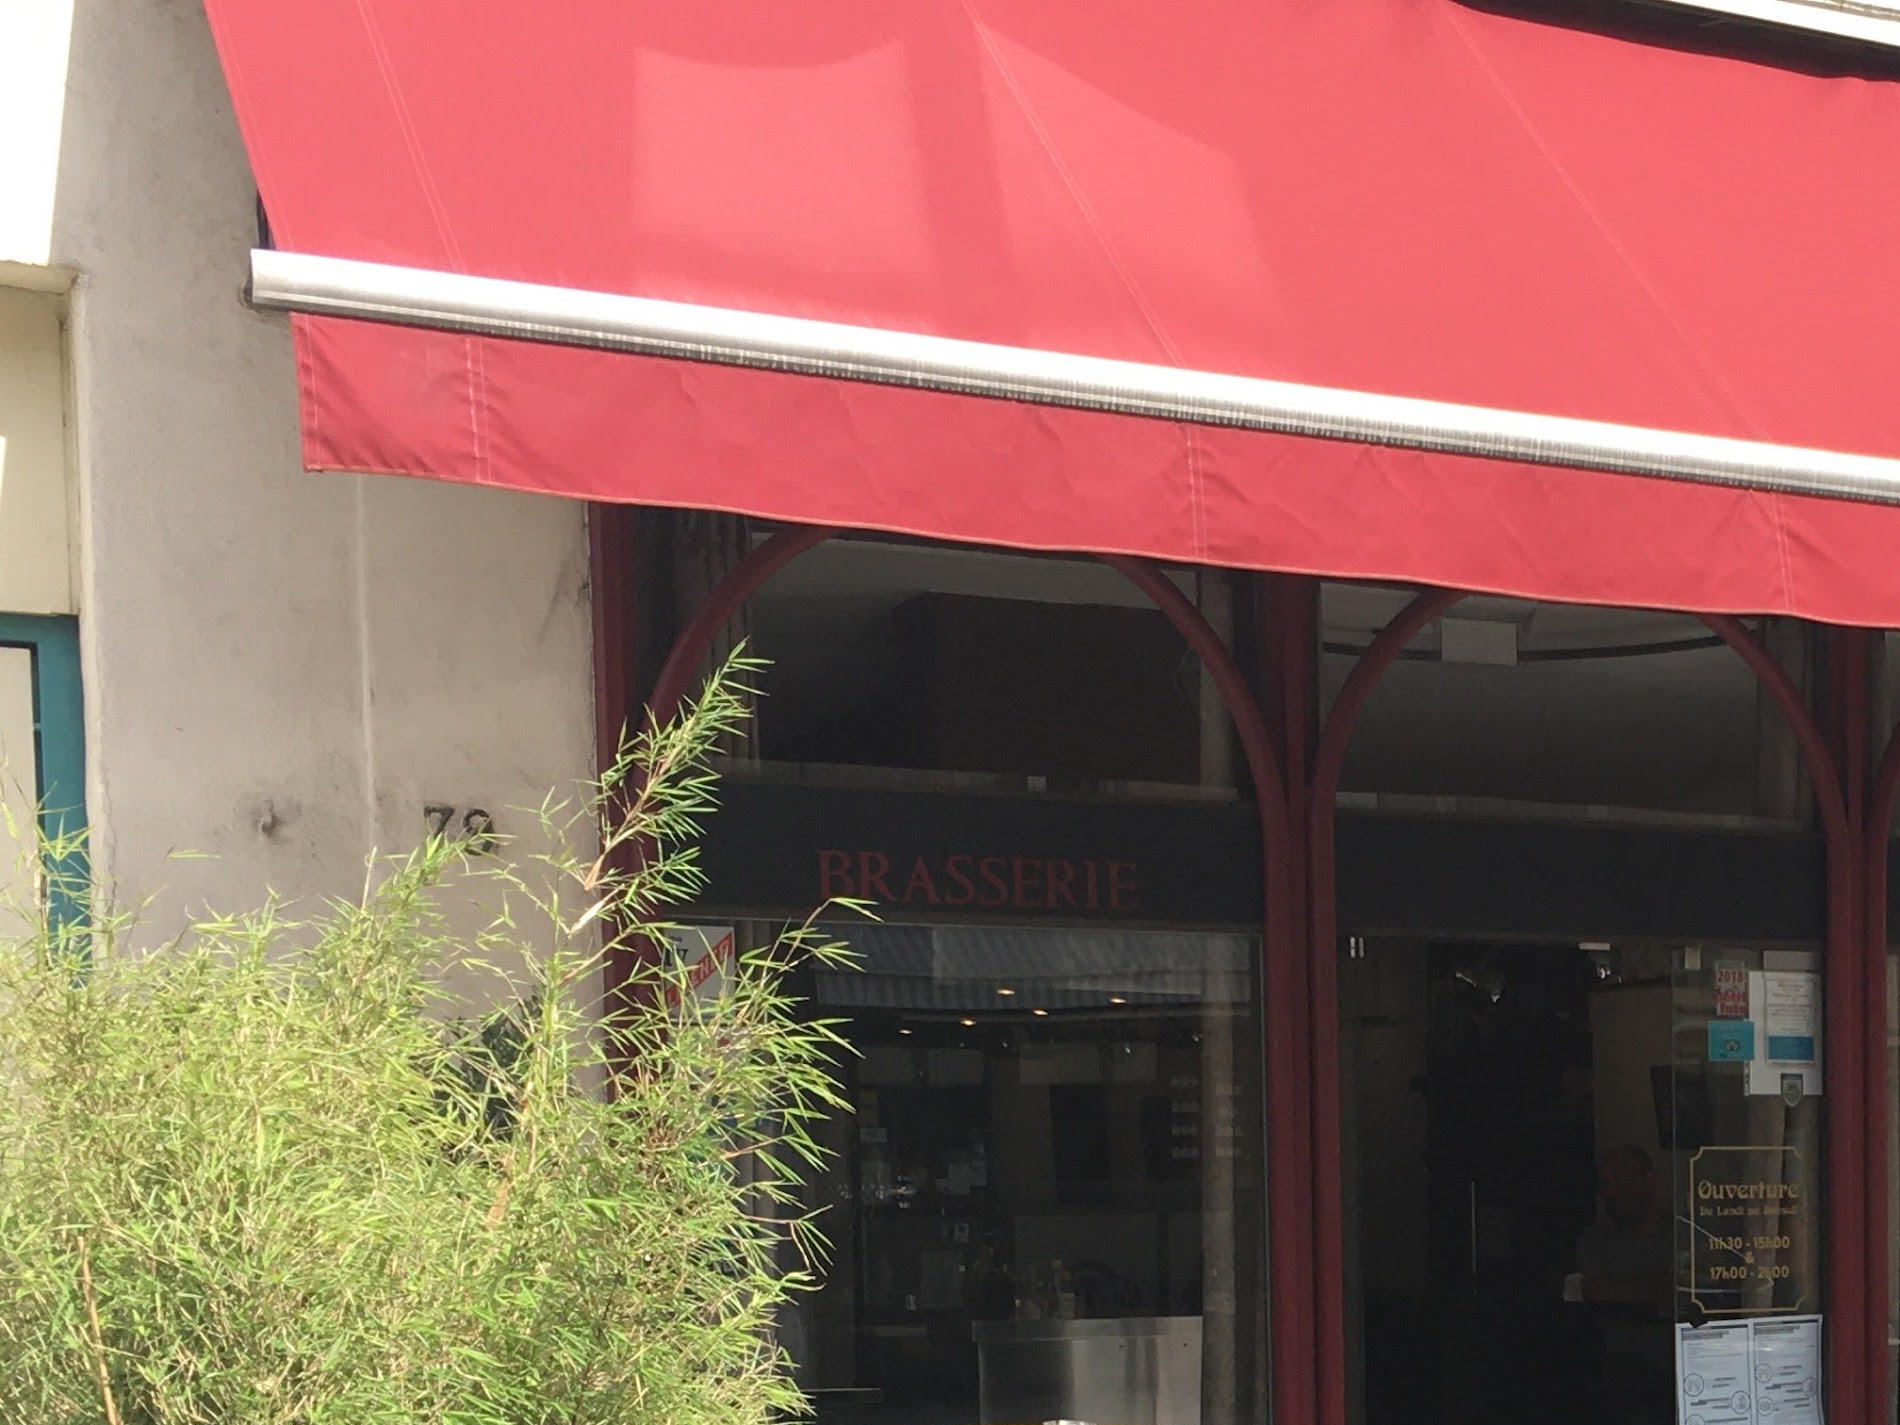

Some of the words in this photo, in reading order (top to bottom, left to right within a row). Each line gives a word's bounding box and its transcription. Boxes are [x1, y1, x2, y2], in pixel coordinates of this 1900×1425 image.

[818, 849, 1138, 911] BRASSERIE
[1697, 1180, 1799, 1200] Ouverture
[1708, 1237, 1743, 1250] 11h30
[1753, 1236, 1790, 1249] 15h00
[1709, 1266, 1747, 1280] 17h00
